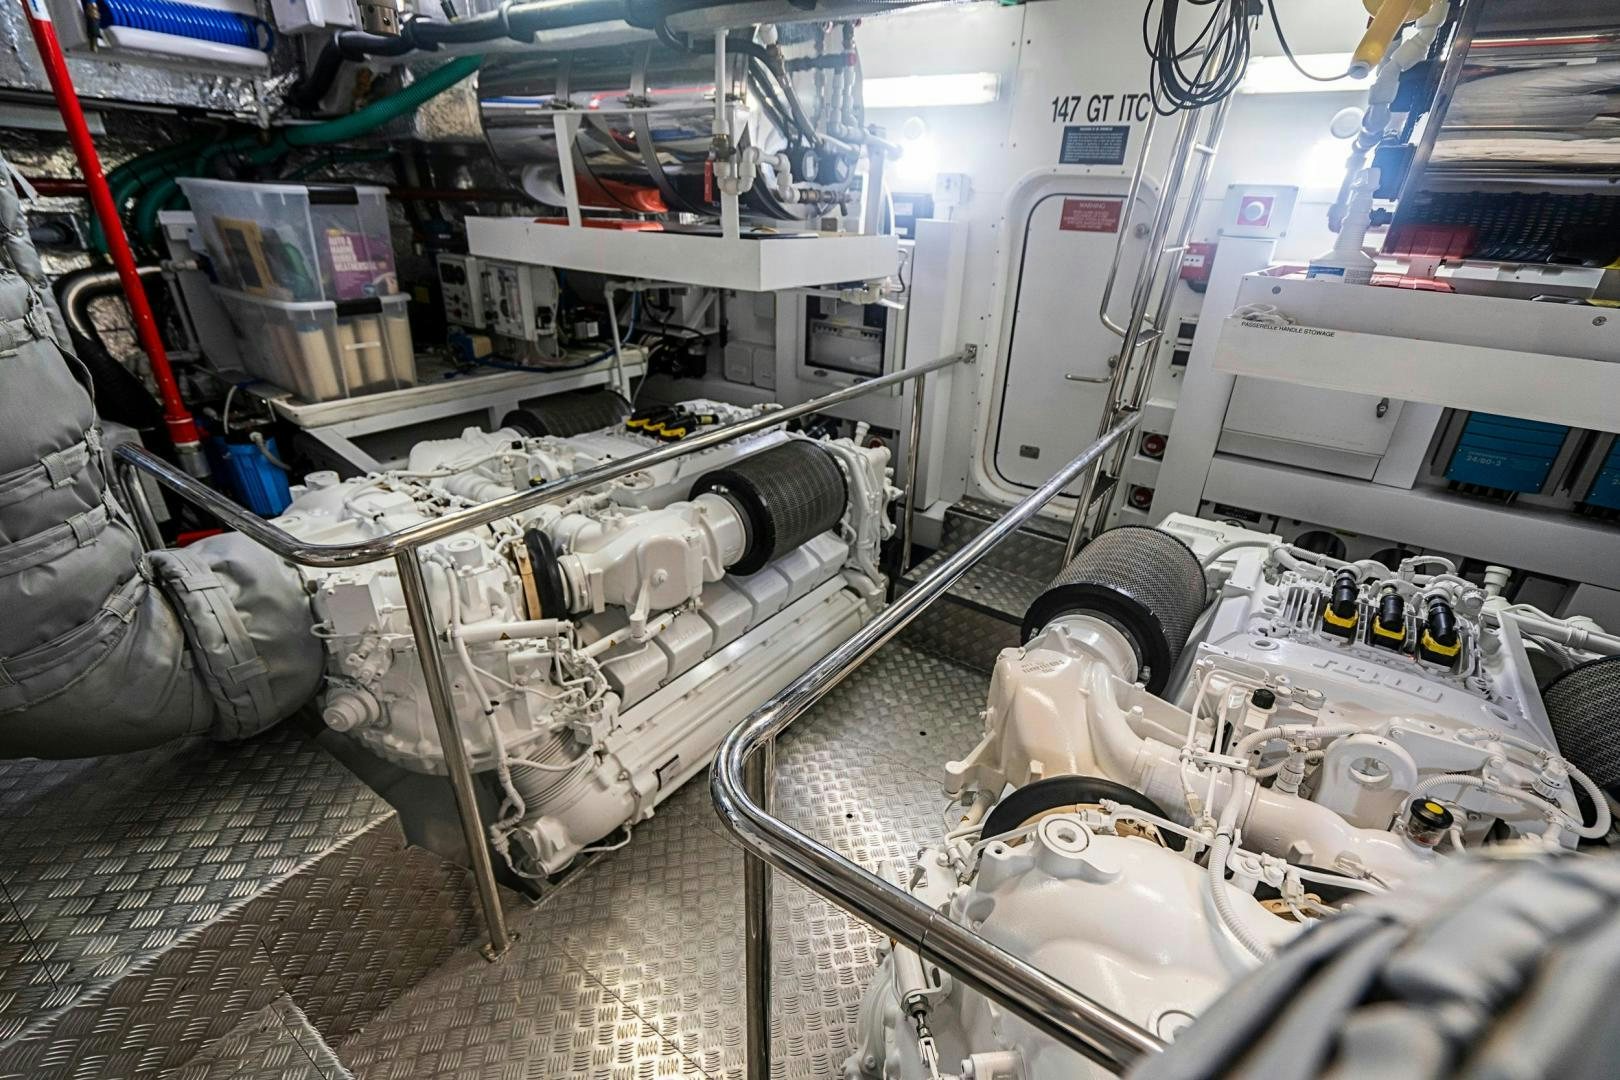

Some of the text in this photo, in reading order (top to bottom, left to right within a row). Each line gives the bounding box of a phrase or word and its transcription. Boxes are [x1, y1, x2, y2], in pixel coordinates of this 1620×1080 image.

[1052, 93, 1151, 122] 147 GT ITC
[1241, 321, 1335, 337] PASSERELLE HANDLE STOWAGE
